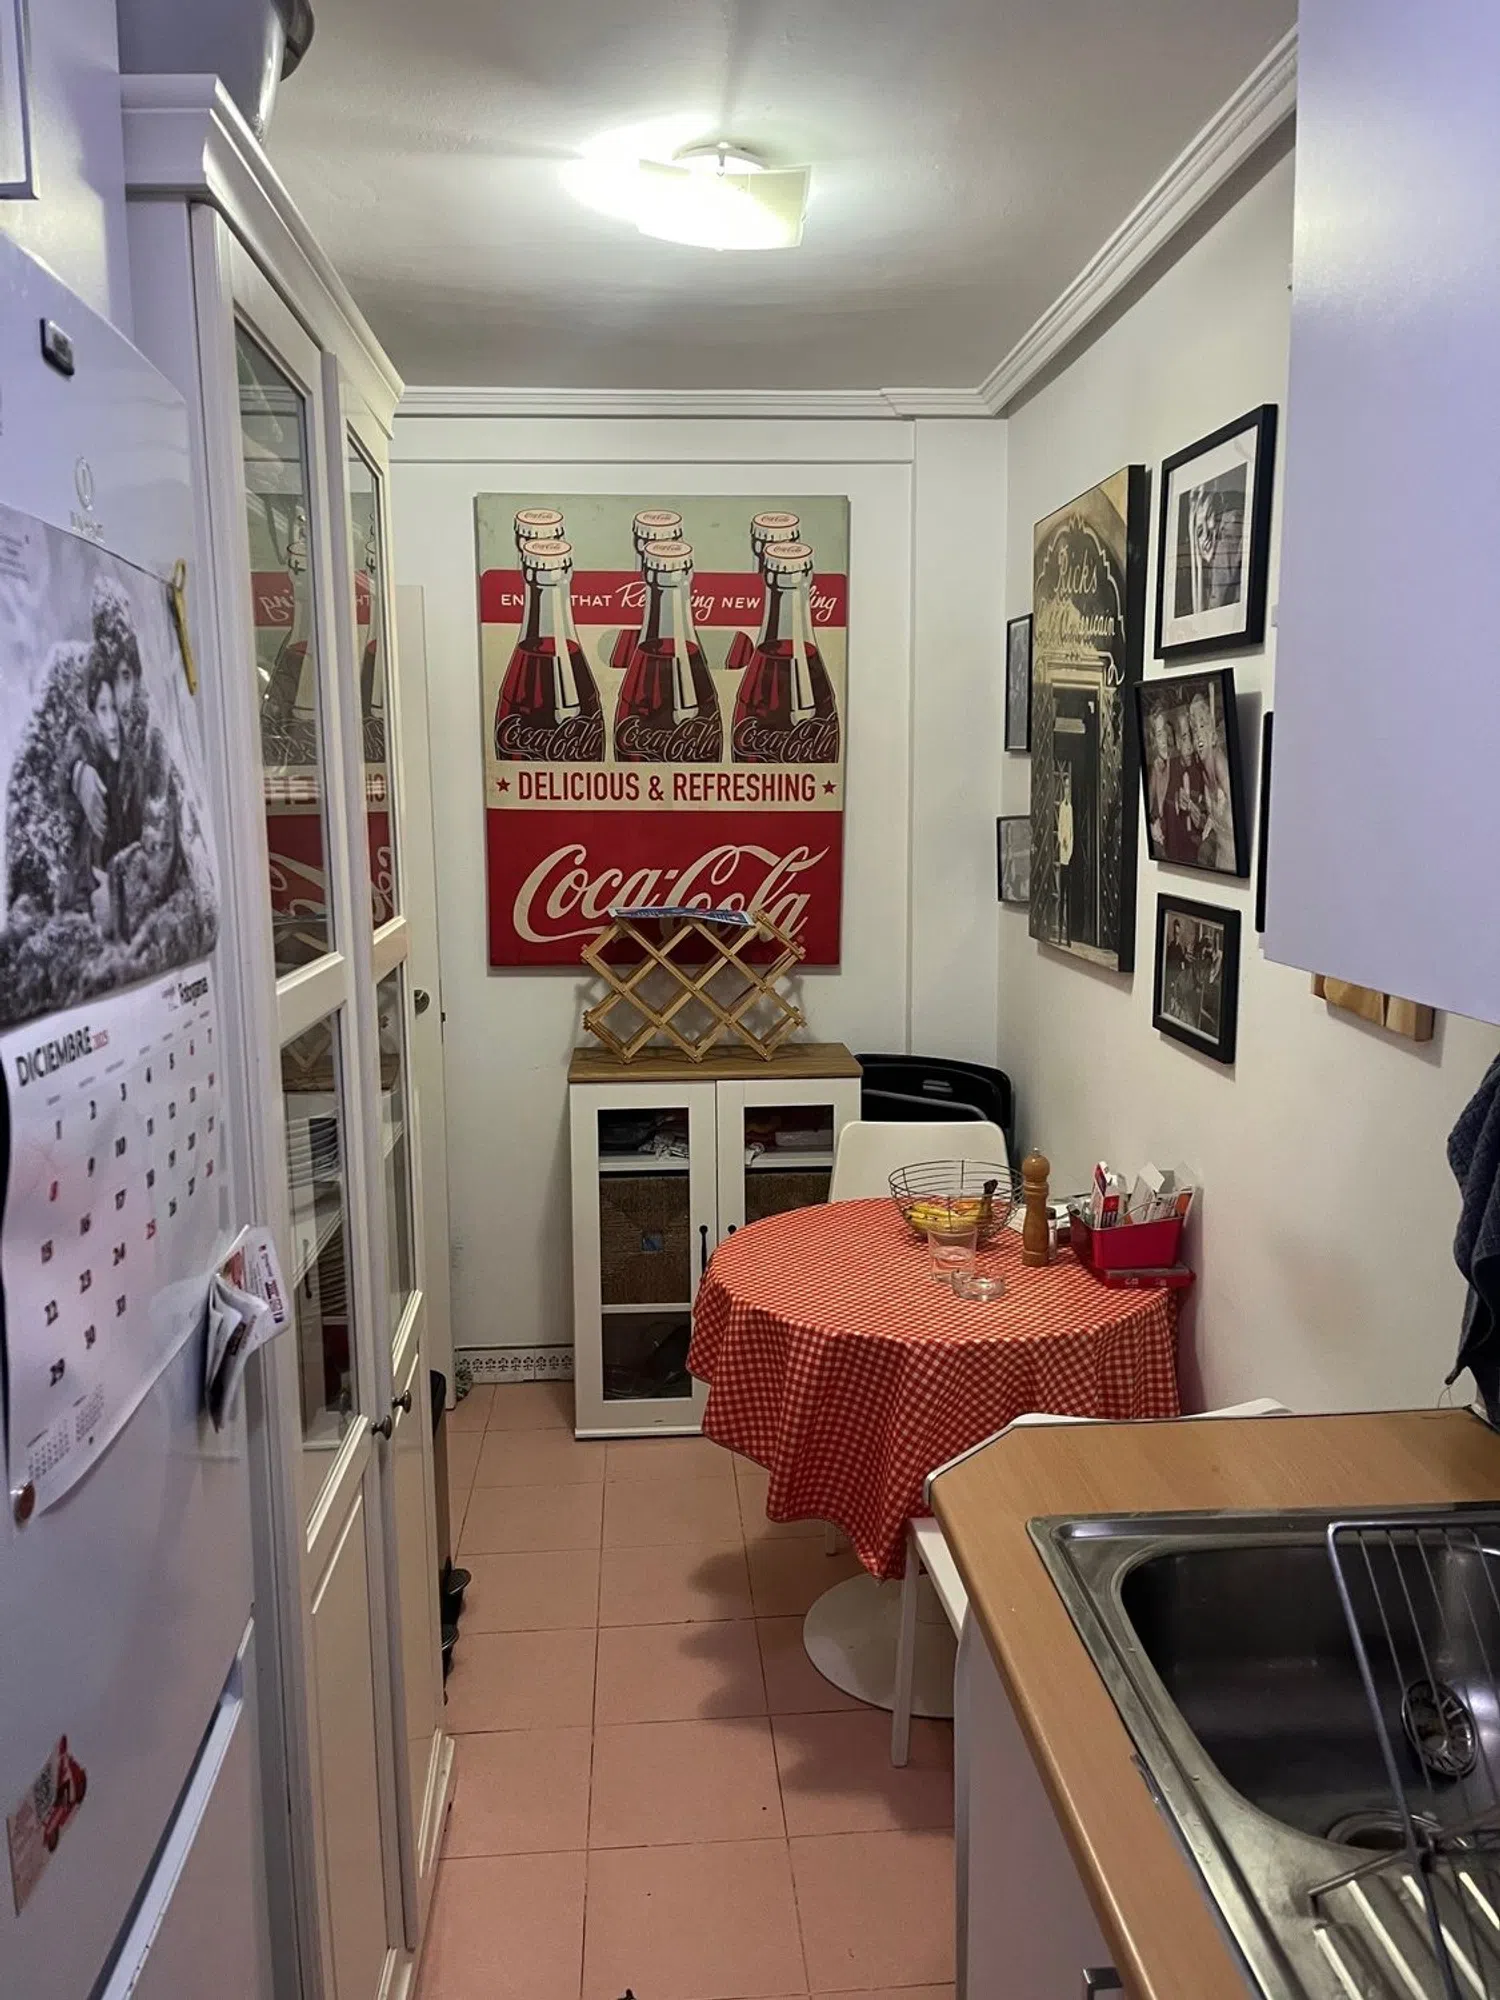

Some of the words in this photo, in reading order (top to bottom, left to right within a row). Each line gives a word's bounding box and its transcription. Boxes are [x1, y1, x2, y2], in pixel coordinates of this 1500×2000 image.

[1054, 545, 1097, 594] Rick's
[571, 595, 612, 607] THAT
[722, 597, 761, 609] NEW
[518, 771, 639, 800] DELICIOUS
[648, 775, 664, 801] &
[673, 773, 816, 801] REFRESHING
[16, 1026, 92, 1087] DICIEMBRE
